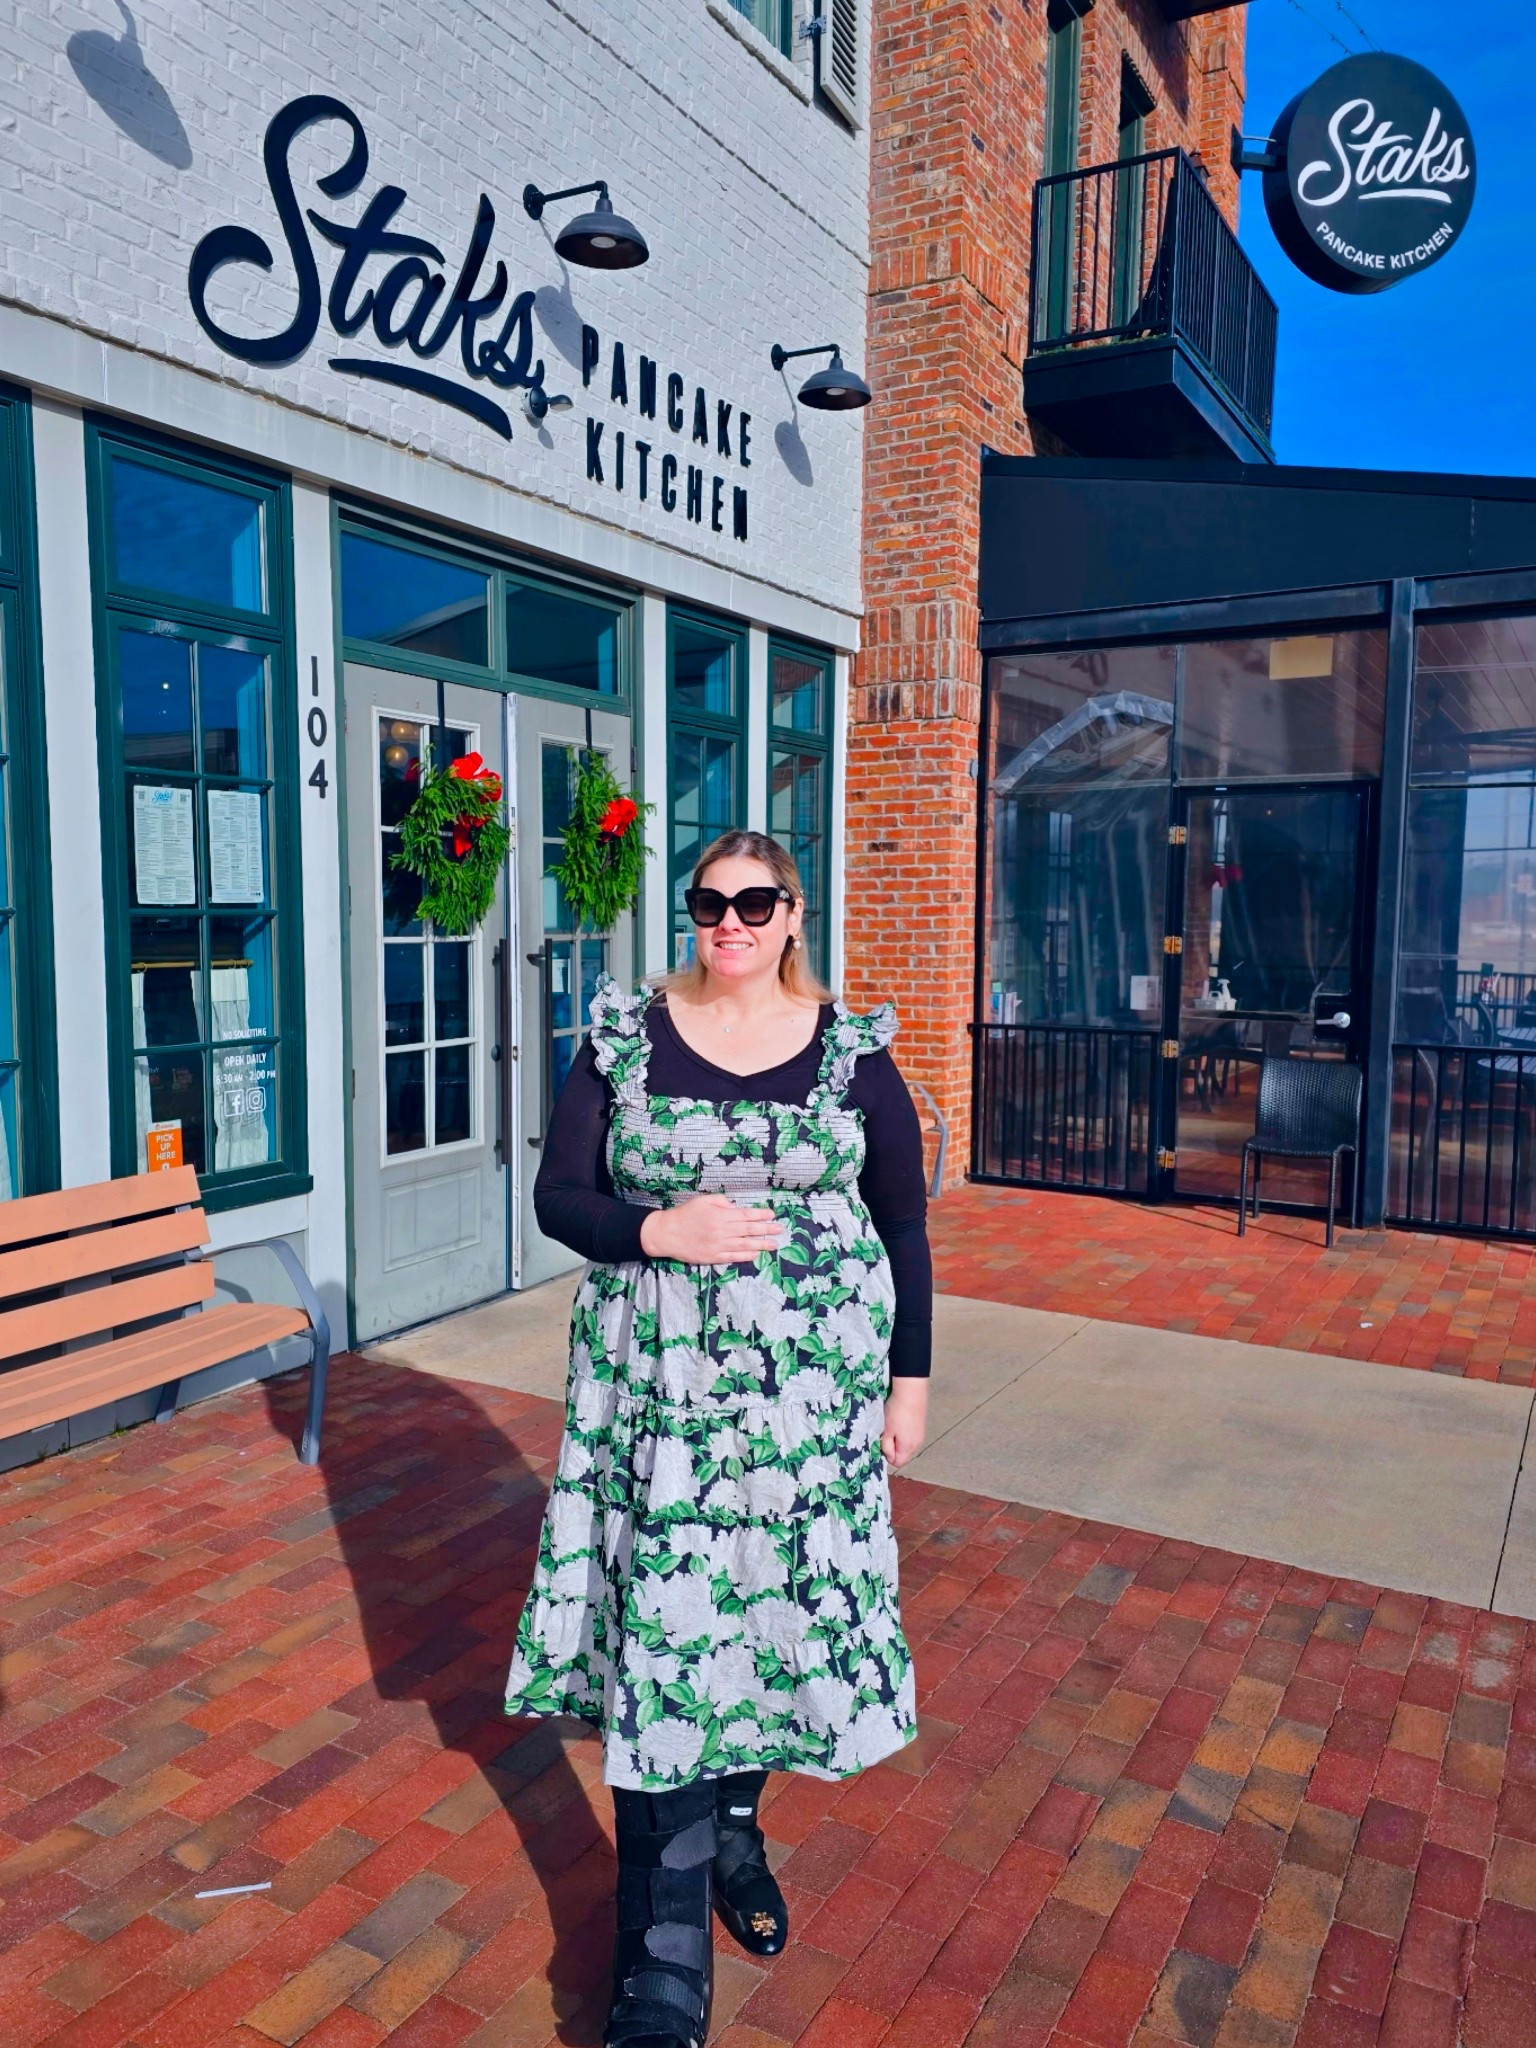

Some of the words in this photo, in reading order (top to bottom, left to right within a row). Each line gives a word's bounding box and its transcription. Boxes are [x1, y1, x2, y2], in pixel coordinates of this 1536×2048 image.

[1298, 98, 1469, 206] Staks
[189, 94, 544, 387] Staks
[1316, 221, 1385, 269] PANCAKE
[1390, 222, 1453, 269] KITCHEN
[582, 324, 752, 468] PANCAKE
[587, 417, 748, 541] KITCHEN
[307, 656, 328, 799] 104
[215, 1073, 232, 1084] 6:30
[249, 1069, 266, 1081] 2:00
[224, 1055, 244, 1067] OPEN
[247, 1053, 267, 1064] DAILY
[156, 1133, 174, 1143] PICK
[156, 1151, 176, 1160] HERE
[160, 1143, 171, 1151] UP
